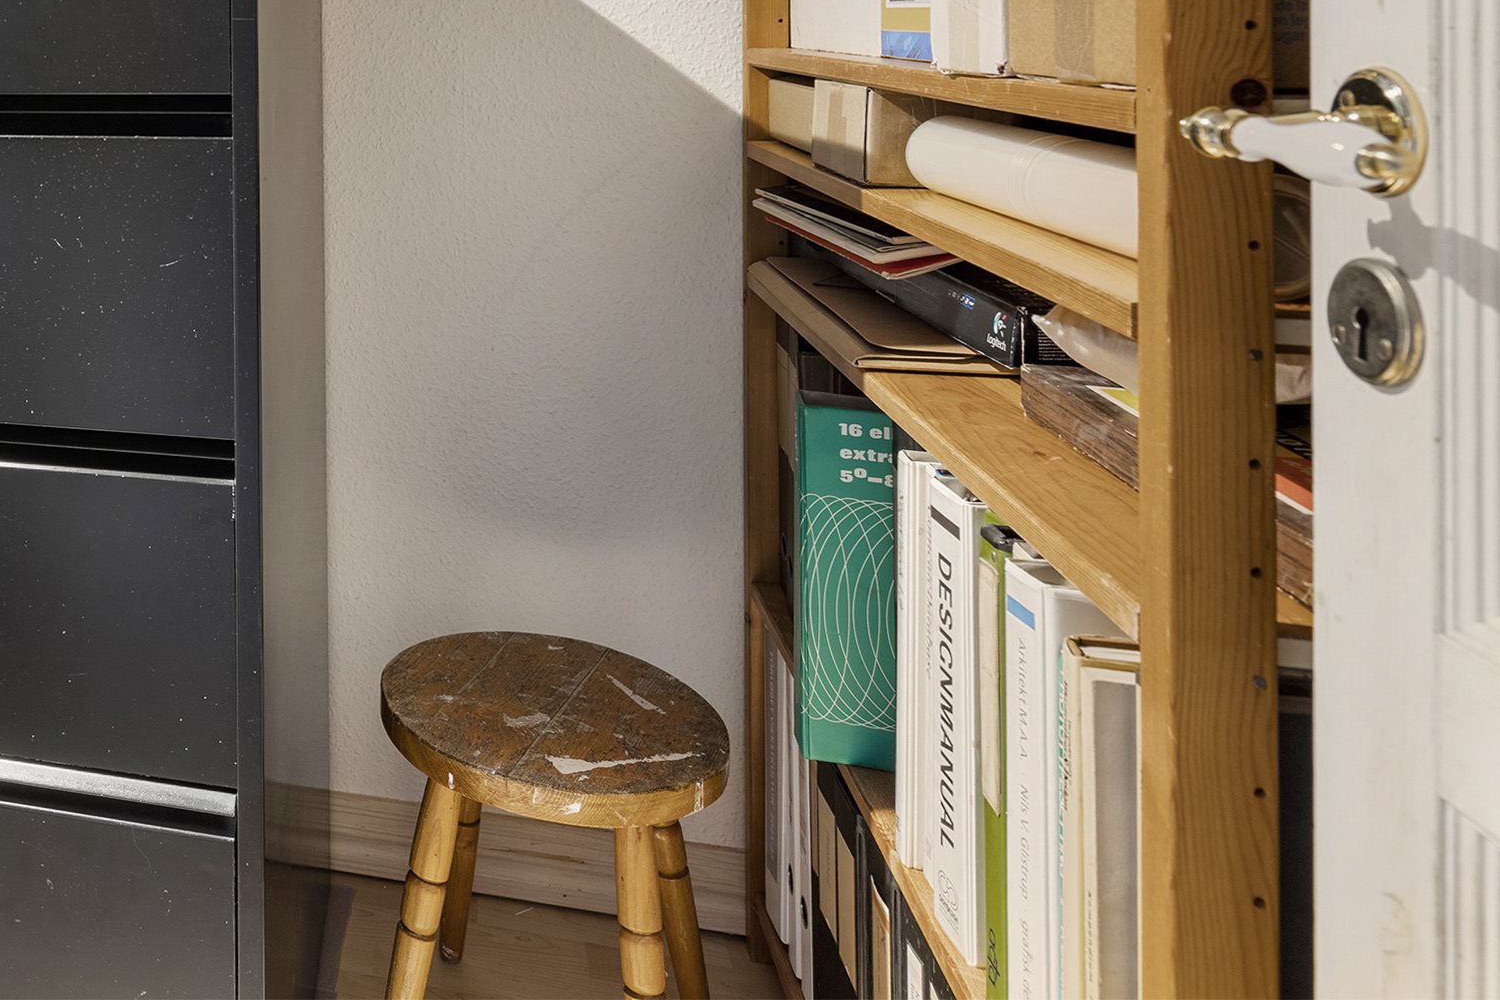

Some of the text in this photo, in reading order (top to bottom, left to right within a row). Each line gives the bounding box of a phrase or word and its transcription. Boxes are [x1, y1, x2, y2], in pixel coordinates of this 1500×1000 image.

[986, 332, 1007, 352] Logitech
[838, 422, 863, 437] 16
[937, 552, 955, 849] DESIGNMANUAL
